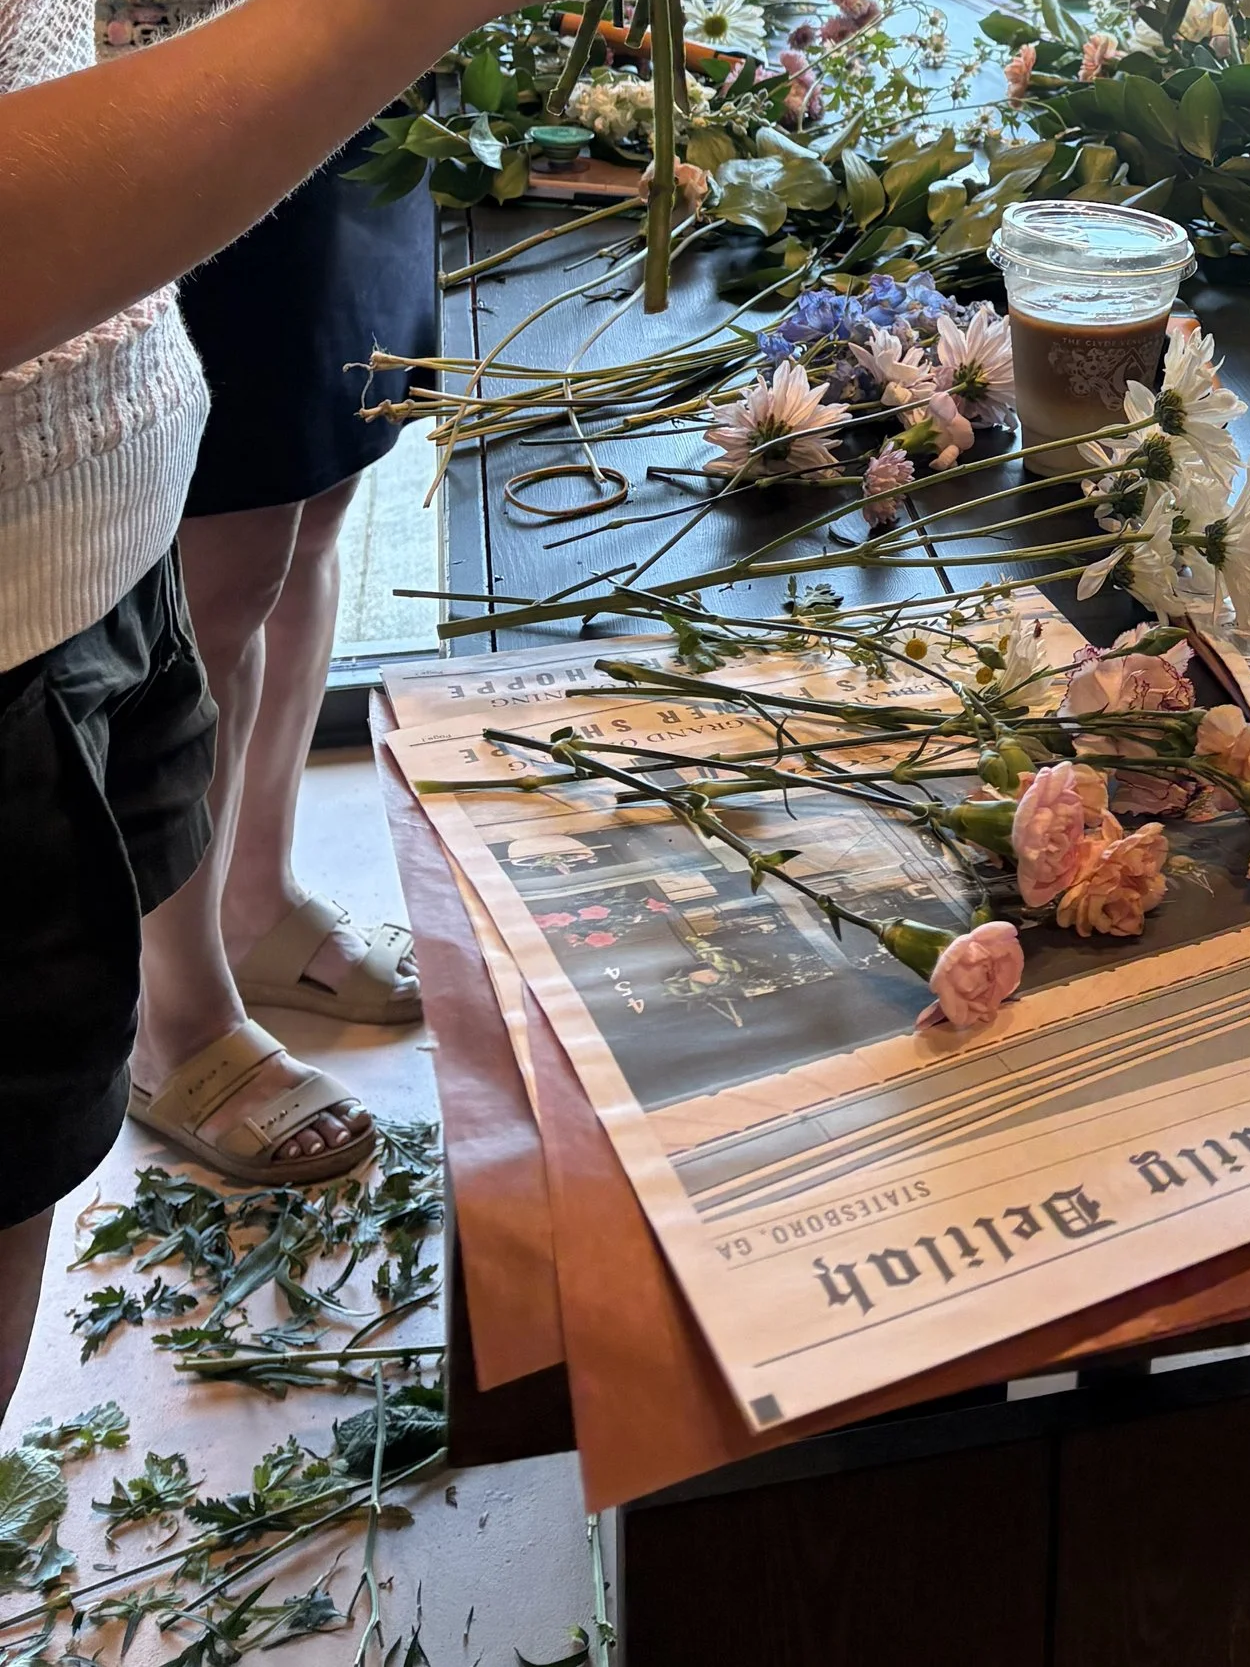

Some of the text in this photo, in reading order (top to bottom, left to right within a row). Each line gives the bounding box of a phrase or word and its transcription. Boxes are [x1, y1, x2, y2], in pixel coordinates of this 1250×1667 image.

[1062, 336, 1081, 346] THE
[1085, 339, 1117, 347] CLYDE
[447, 668, 609, 699] HOPPE
[458, 718, 633, 764] SHPE
[646, 719, 744, 743] GRAND
[715, 1237, 753, 1261] GA
[812, 1183, 1117, 1316] Delilah
